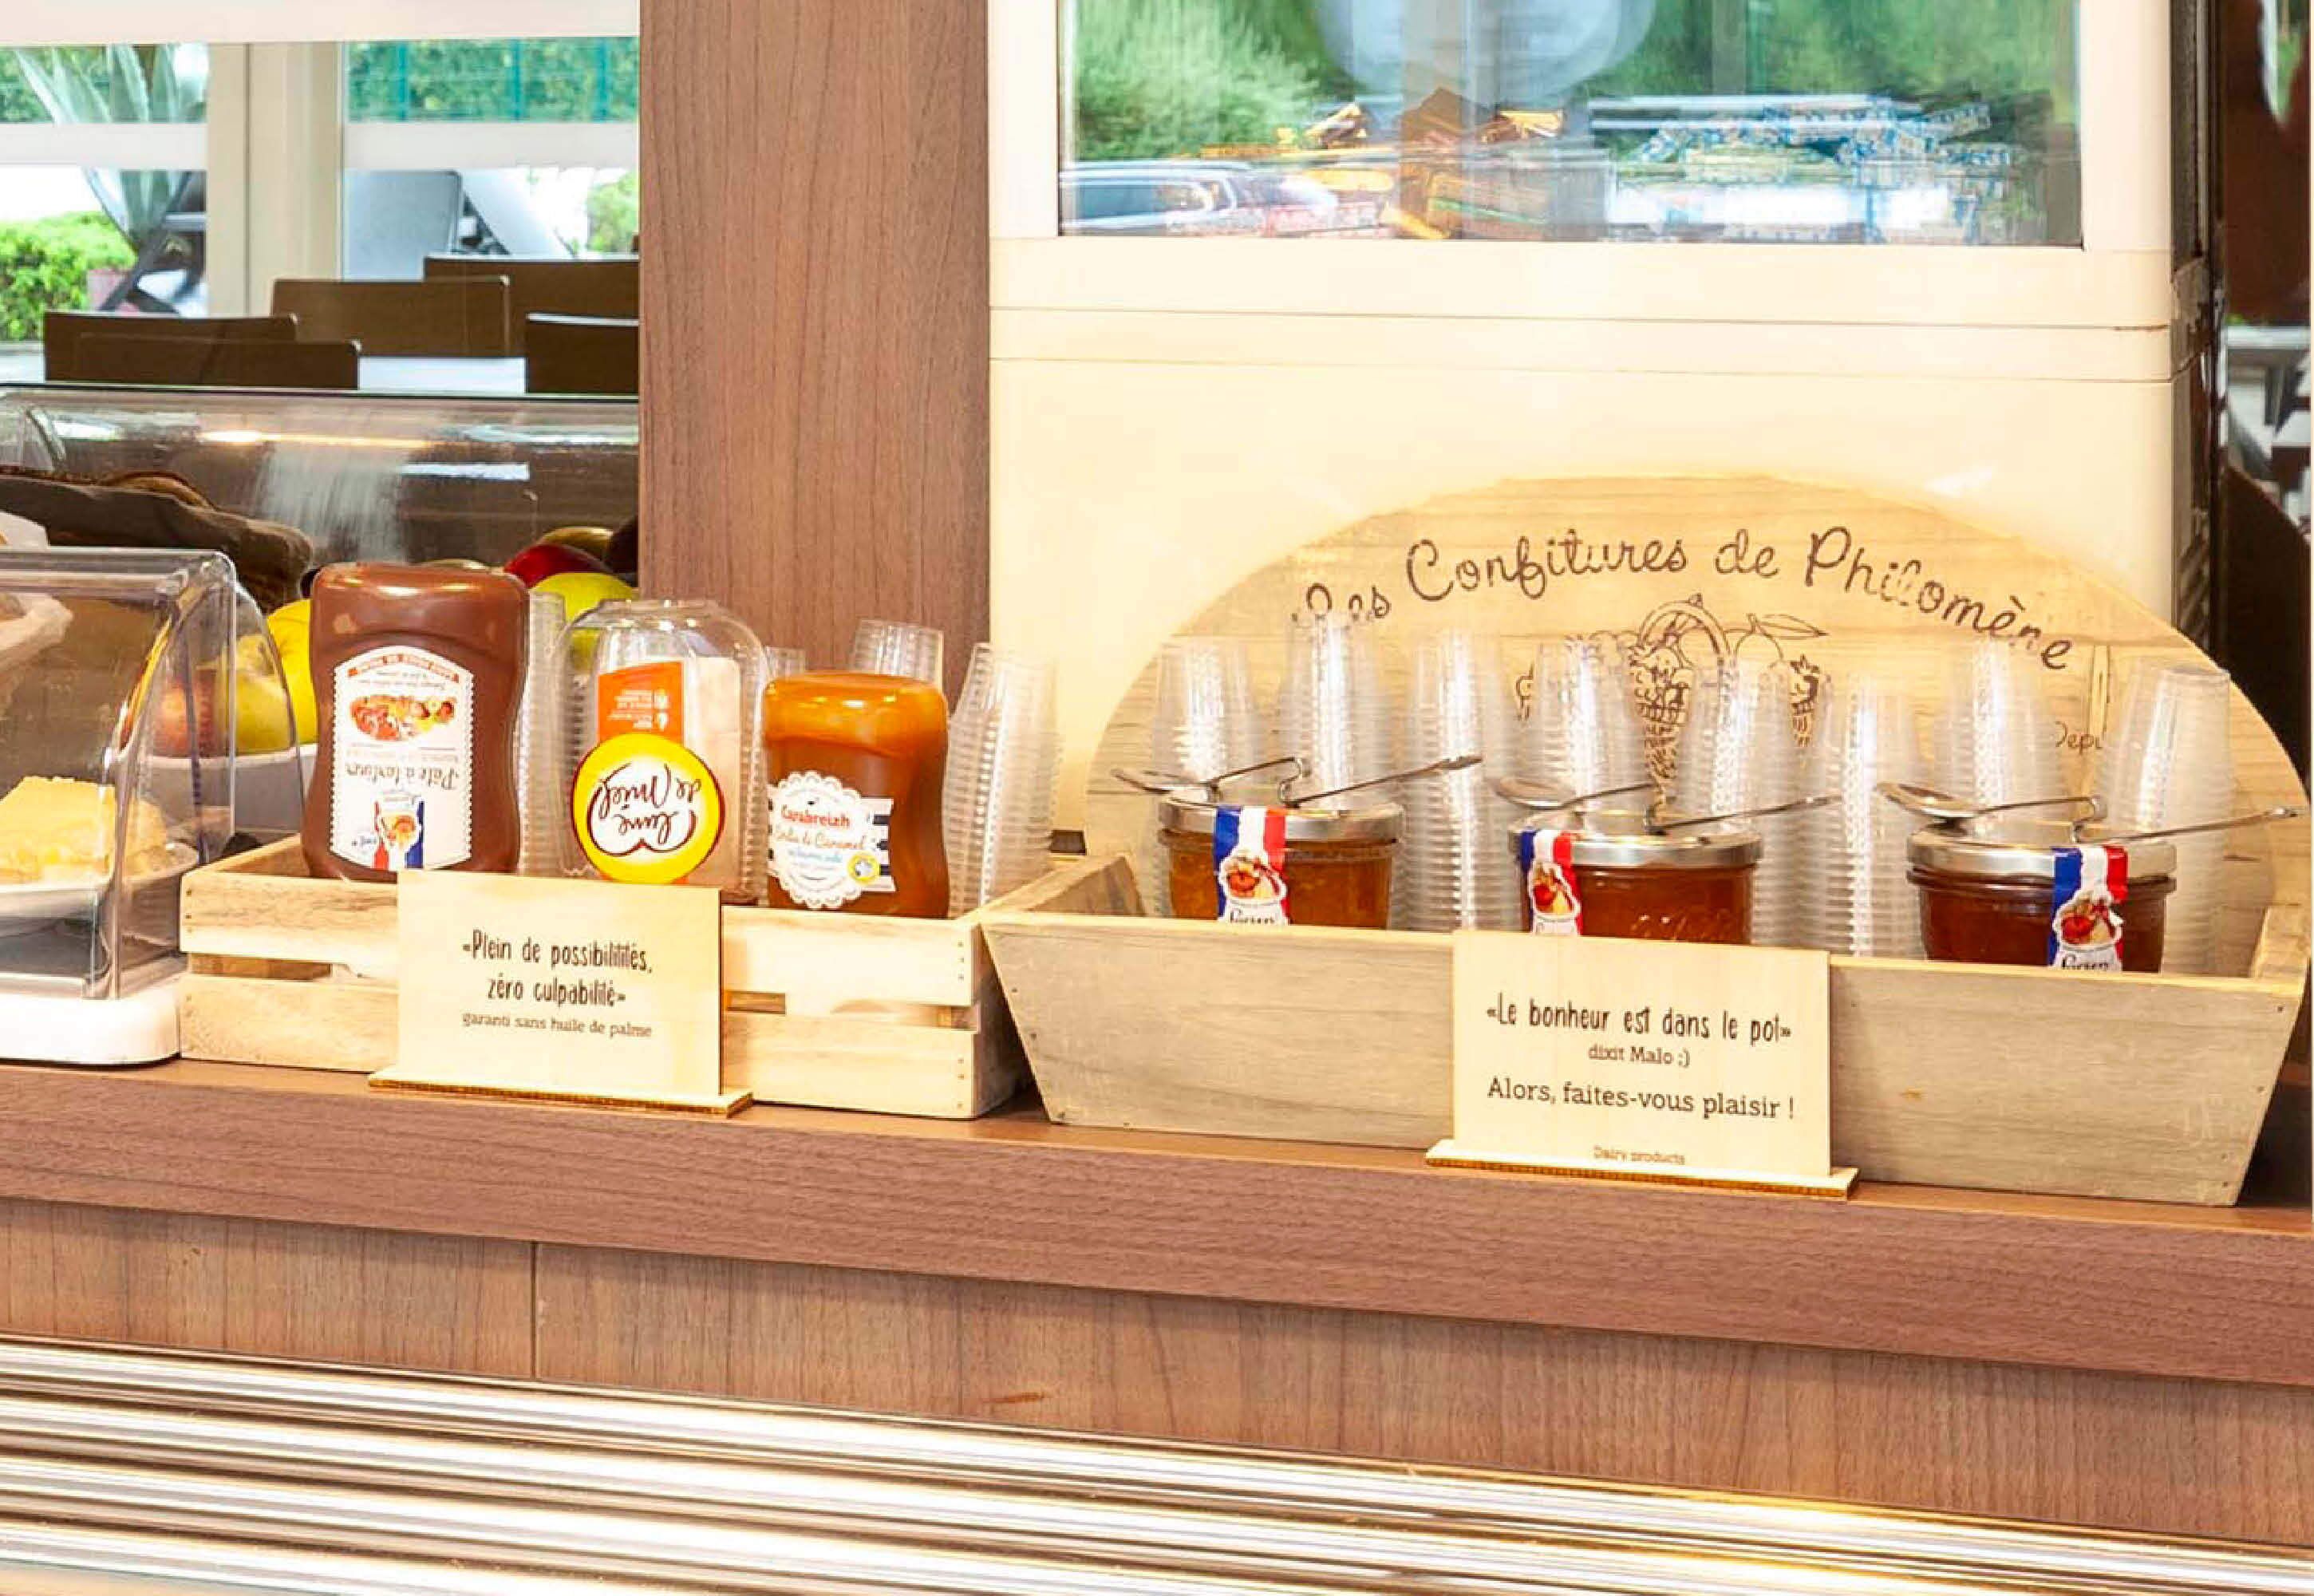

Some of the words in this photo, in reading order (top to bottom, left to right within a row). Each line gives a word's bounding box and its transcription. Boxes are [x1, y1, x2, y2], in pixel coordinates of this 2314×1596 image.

[1406, 528, 1688, 602] Confitures
[1715, 527, 1780, 578] de
[1804, 525, 2073, 670] Philomène
[462, 928, 512, 959] «Plein
[522, 936, 541, 963] de
[488, 971, 524, 1000] zéro
[462, 1012, 511, 1028] garanti
[515, 1017, 547, 1029] sans
[551, 1017, 586, 1033] huile
[589, 1019, 606, 1034] de
[610, 1022, 653, 1039] palme
[1487, 990, 1517, 1025] «Le
[1529, 995, 1610, 1031] bonheur
[1624, 1005, 1650, 1035] est
[1662, 1006, 1710, 1038] dans
[1723, 1009, 1738, 1040] le
[1589, 1042, 1625, 1061] dixit
[1630, 1045, 1674, 1065] Malo
[1487, 1075, 1557, 1105] Alors,
[1562, 1080, 1694, 1112] faites-vous
[1702, 1092, 1781, 1120] plaisir
